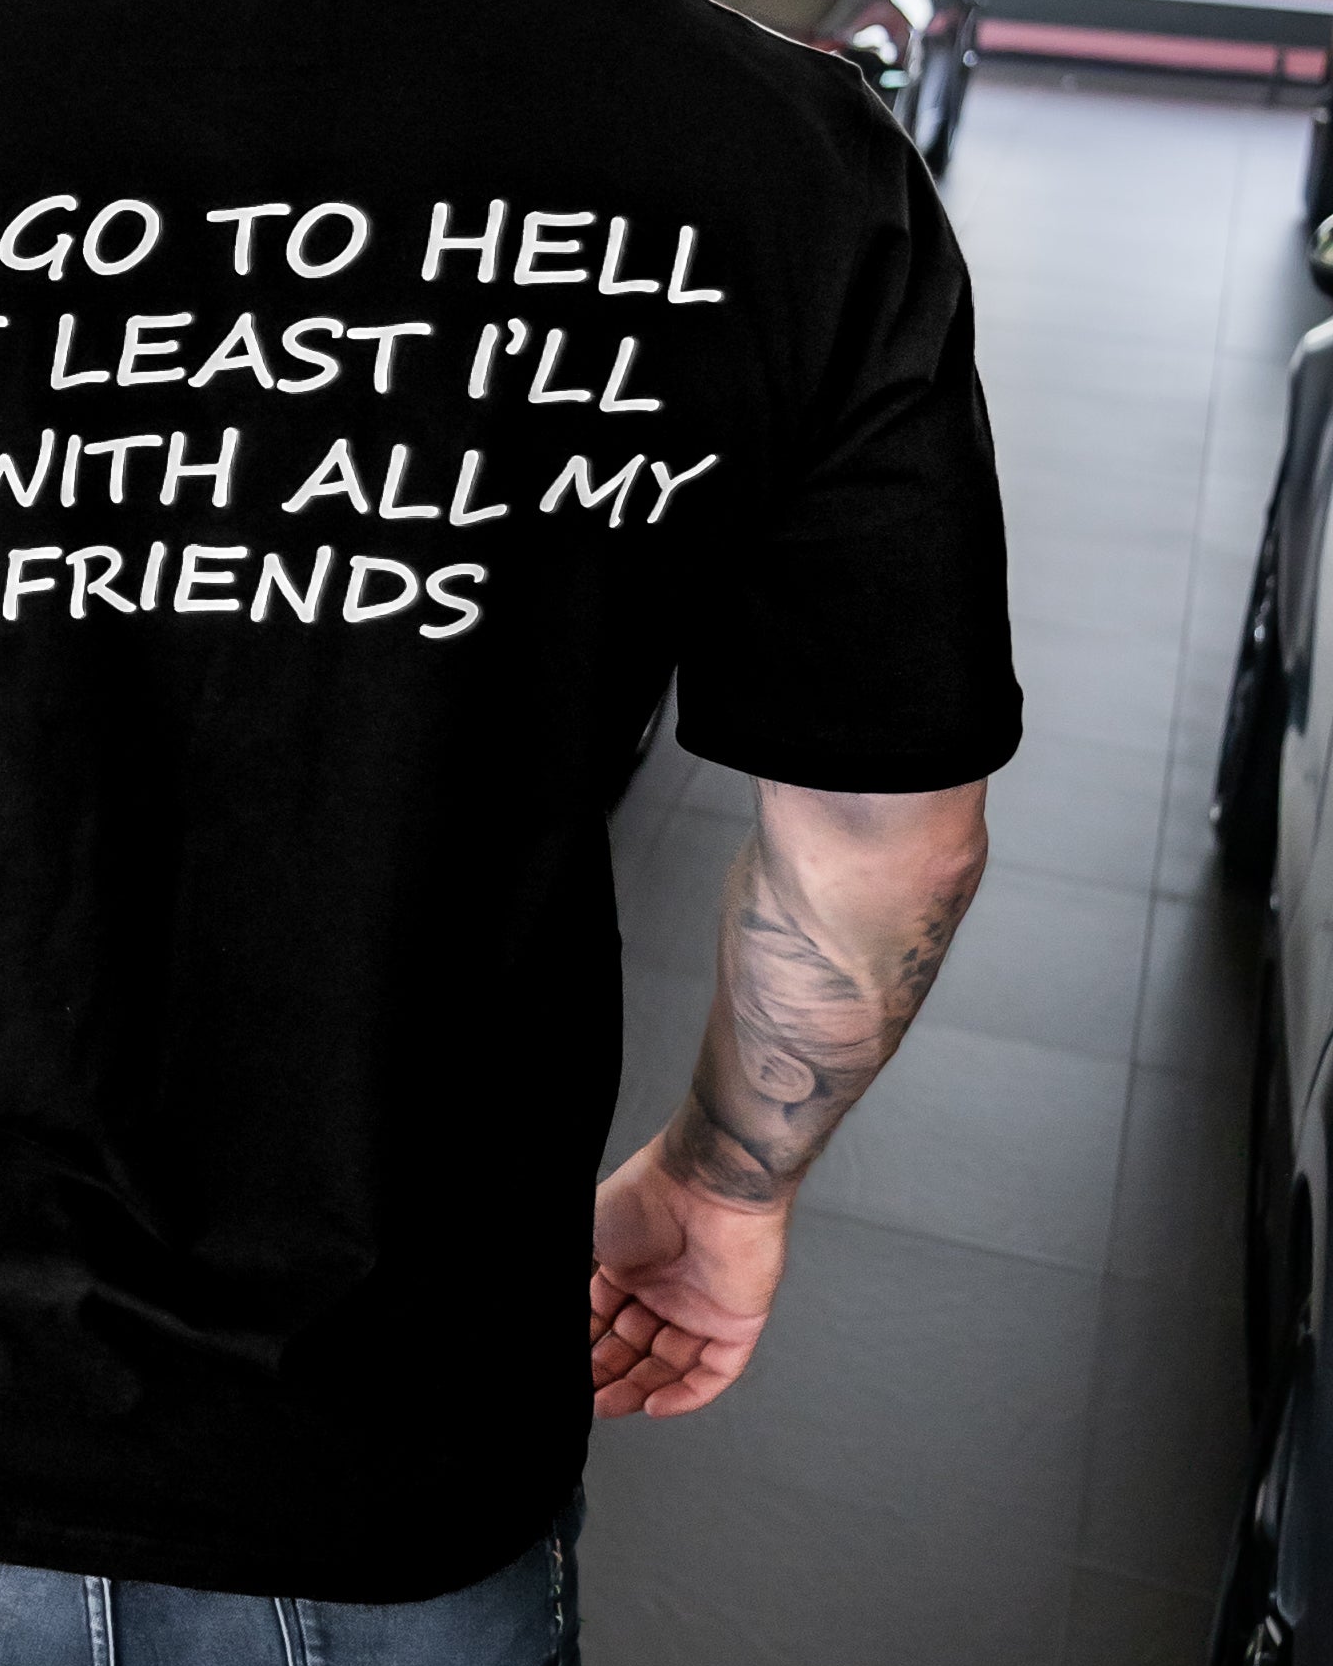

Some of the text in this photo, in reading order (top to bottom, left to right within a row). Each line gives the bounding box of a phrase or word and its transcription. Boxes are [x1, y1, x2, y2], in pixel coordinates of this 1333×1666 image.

[206, 200, 368, 279] TO
[421, 198, 724, 304] HELL
[50, 311, 434, 395] LEAST
[467, 317, 662, 413] I'LL
[281, 438, 508, 527] ALL
[539, 453, 718, 529] MY
[2, 540, 486, 639] FRIENDS
